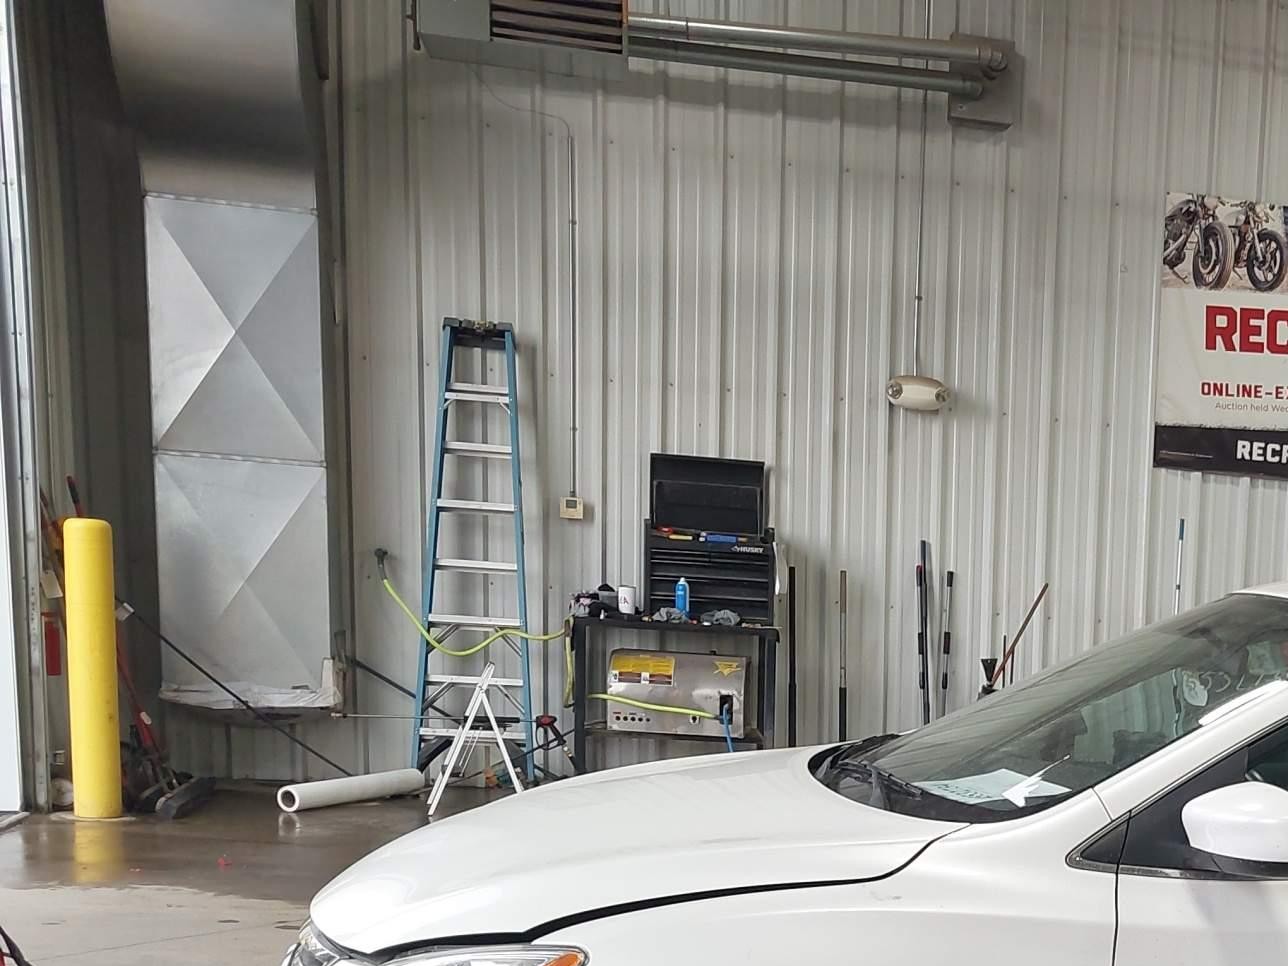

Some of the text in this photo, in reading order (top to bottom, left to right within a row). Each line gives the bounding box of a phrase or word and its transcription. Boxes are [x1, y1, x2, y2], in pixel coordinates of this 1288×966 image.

[1215, 401, 1248, 412] Auction
[1250, 403, 1269, 412] held
[740, 546, 765, 554] HUSKY
